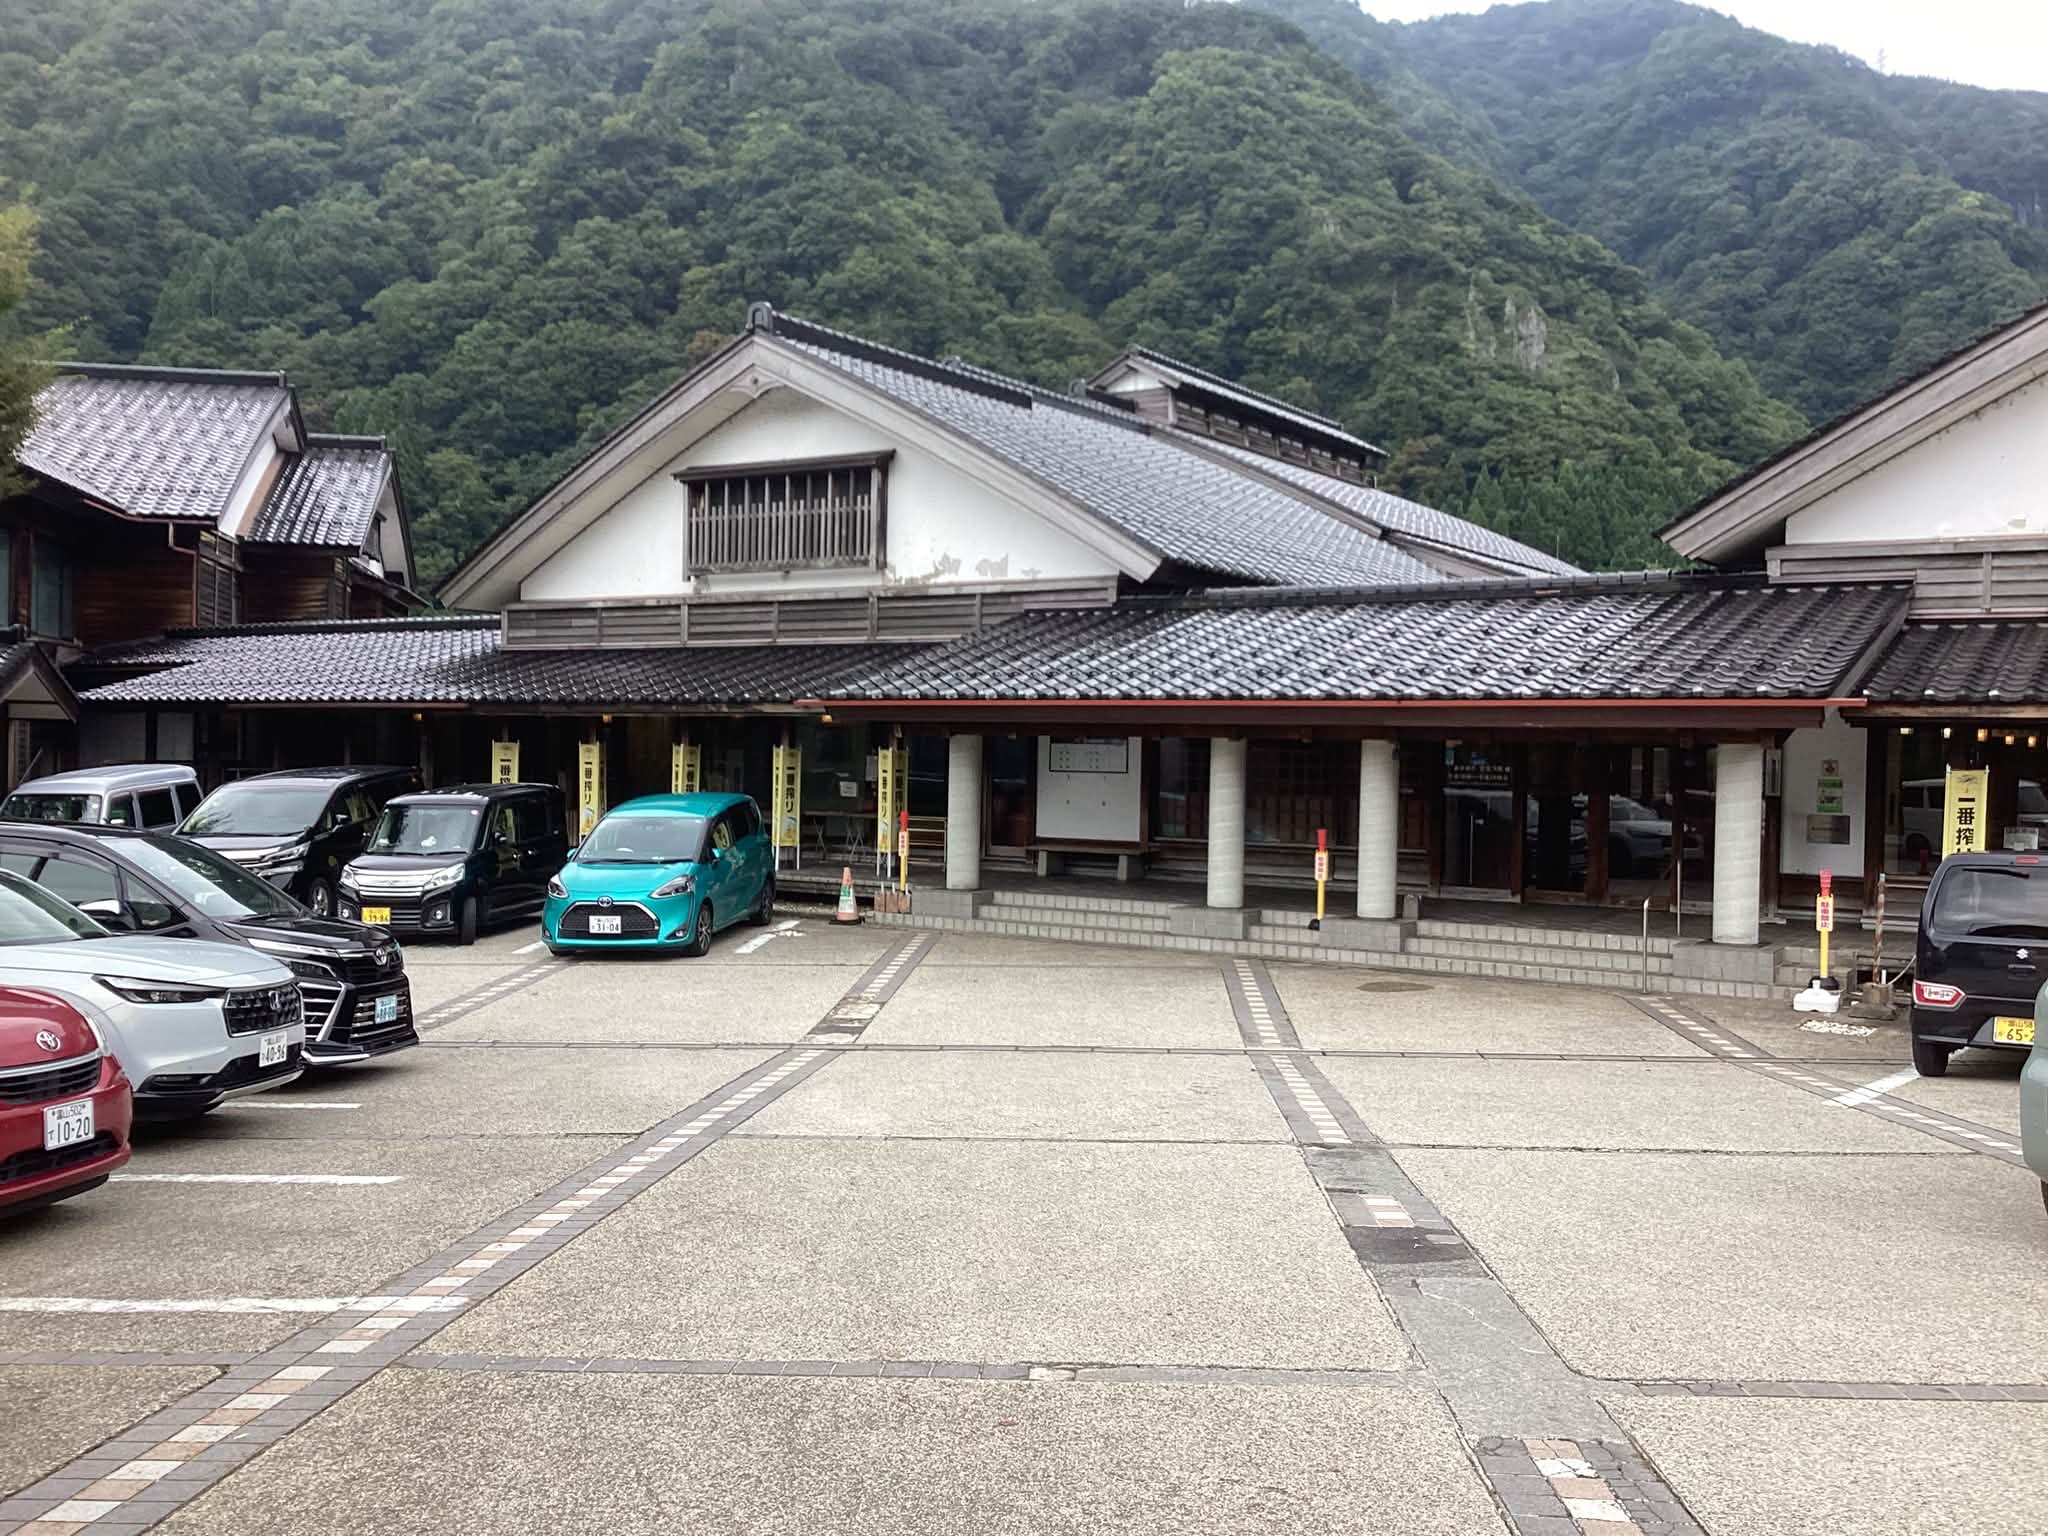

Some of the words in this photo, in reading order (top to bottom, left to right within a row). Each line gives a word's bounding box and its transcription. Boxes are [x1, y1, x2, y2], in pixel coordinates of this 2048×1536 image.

[584, 761, 593, 805] 一番搾り
[786, 767, 795, 813] 一番搾り
[1956, 797, 1975, 853] 一番搾
